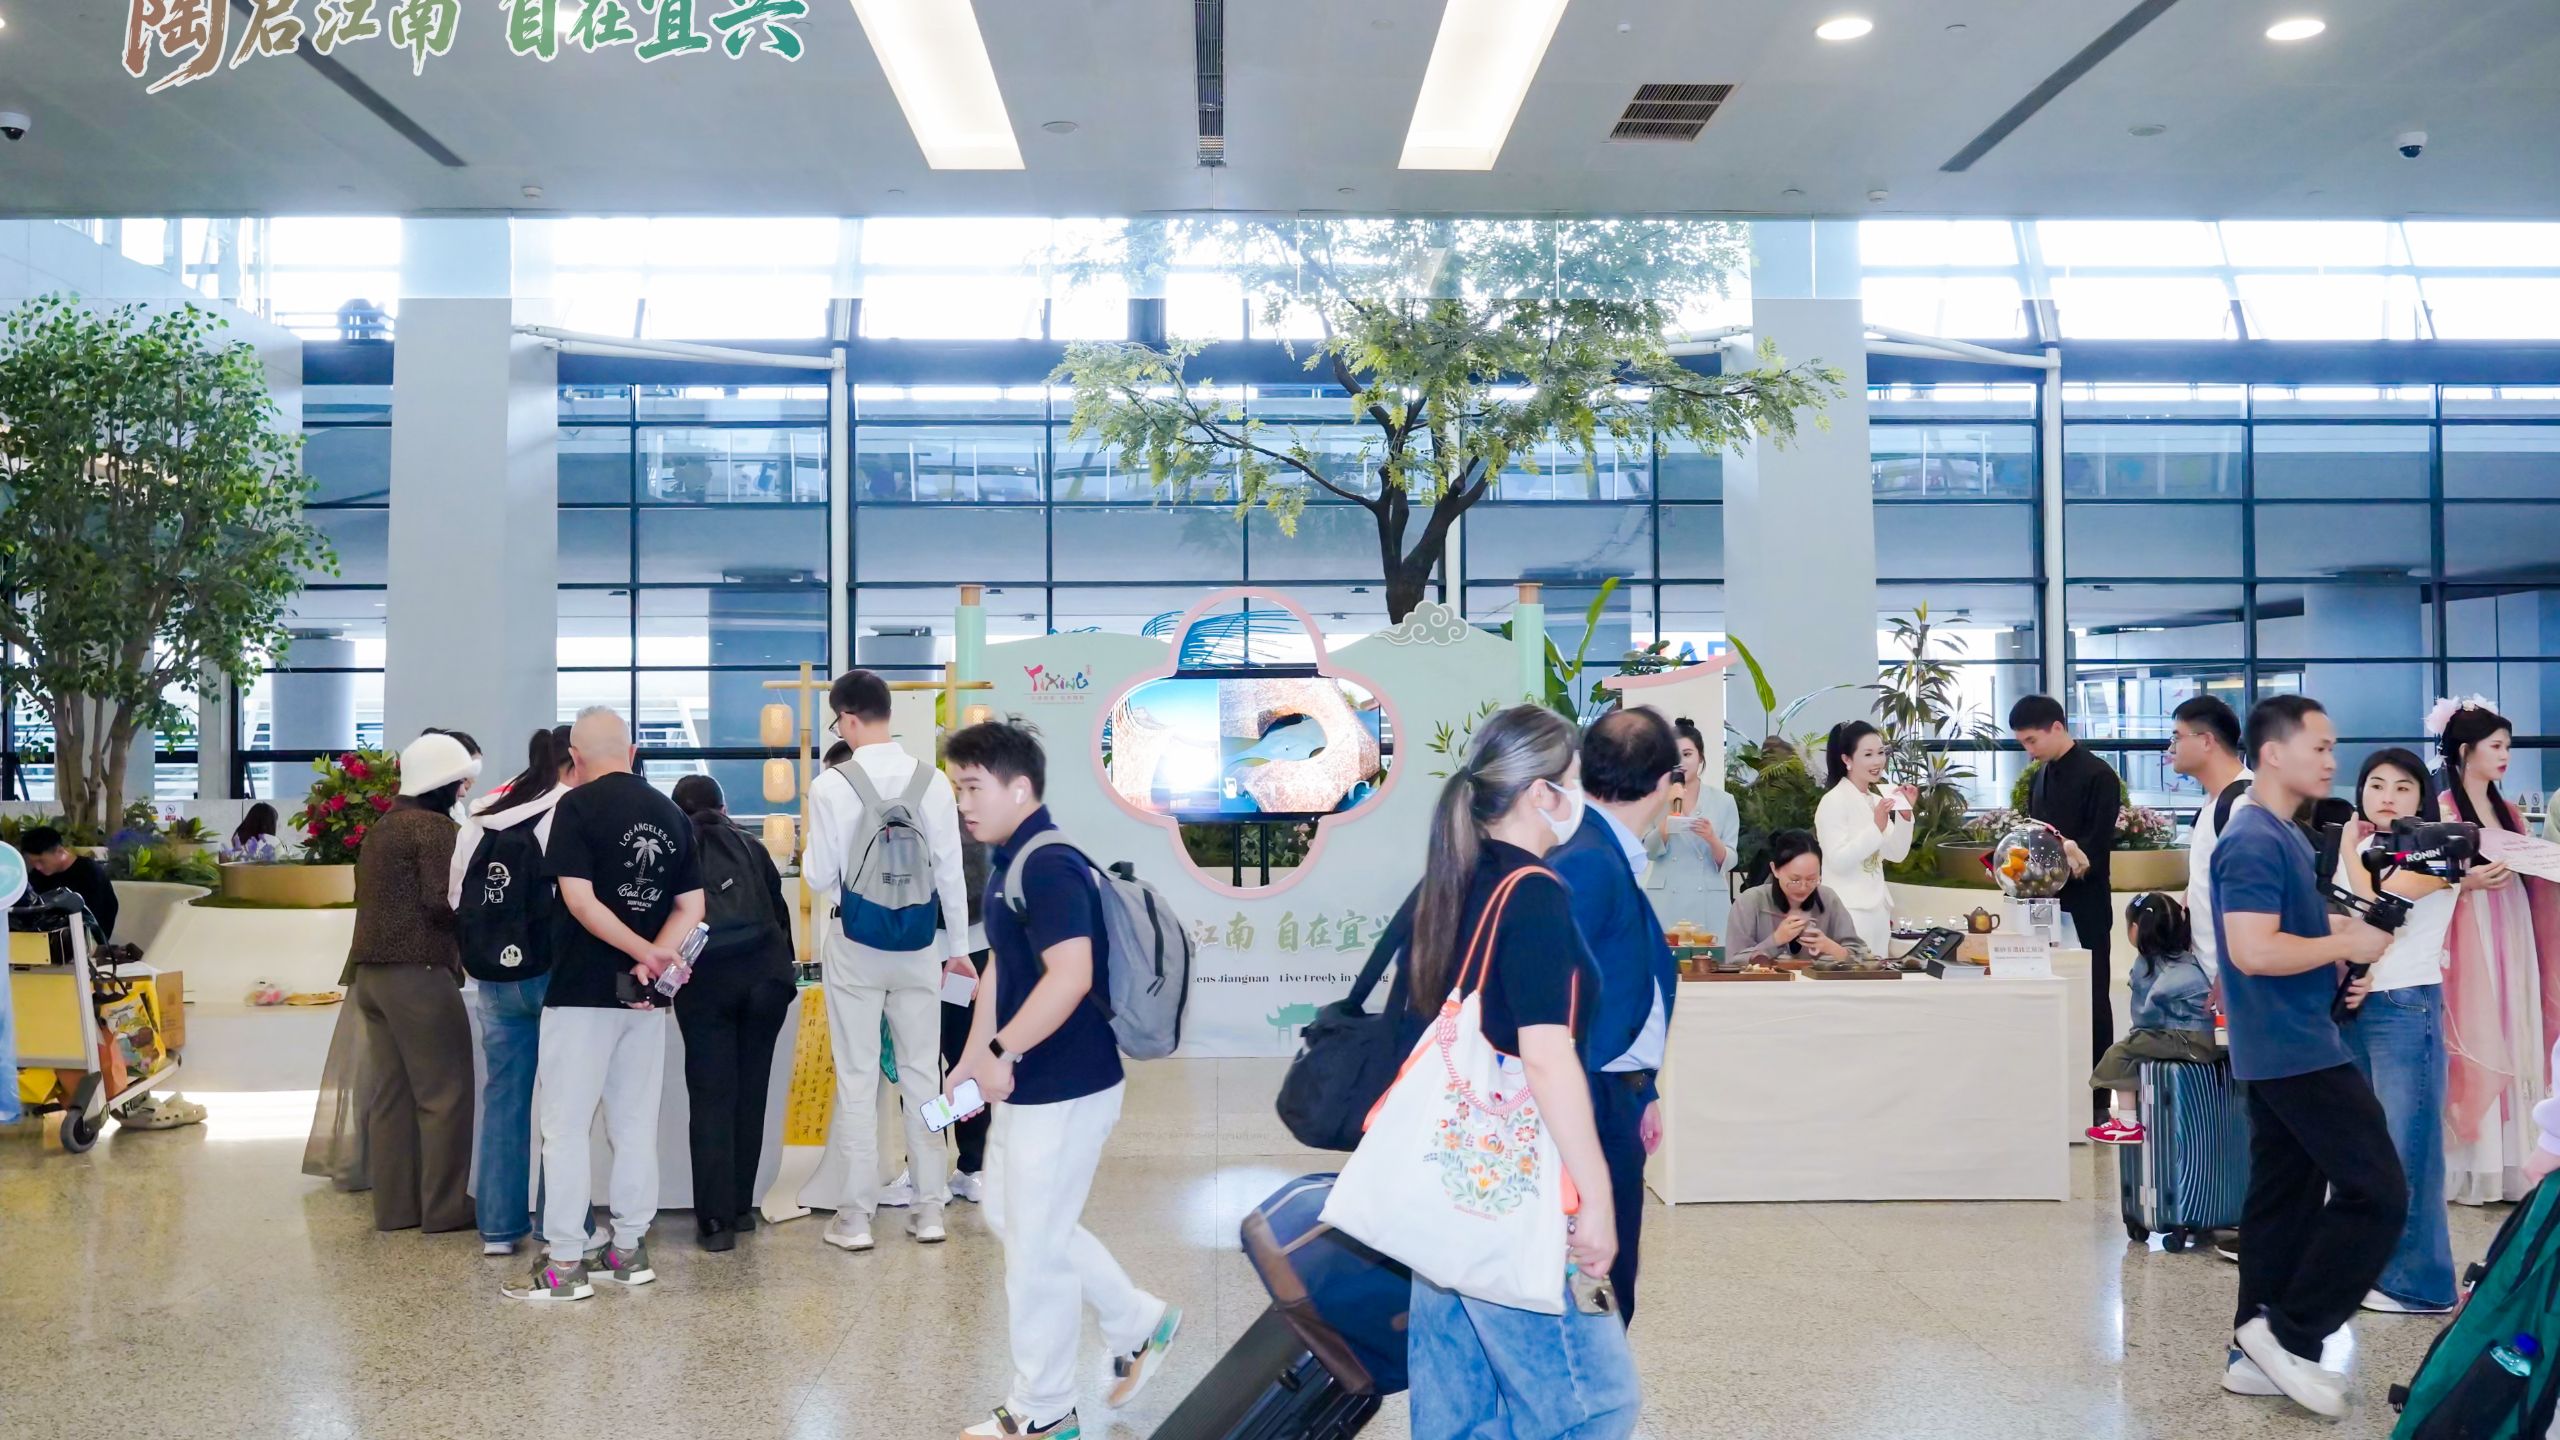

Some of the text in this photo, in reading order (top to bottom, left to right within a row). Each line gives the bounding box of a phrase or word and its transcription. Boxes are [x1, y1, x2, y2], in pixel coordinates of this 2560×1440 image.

[499, 0, 810, 63] 自在宜兴
[2405, 847, 2441, 862] RONIN
[1193, 975, 1216, 984] ens
[1218, 973, 1269, 986] Jiangnan
[1279, 973, 1302, 983] Live
[1341, 973, 1351, 983] in
